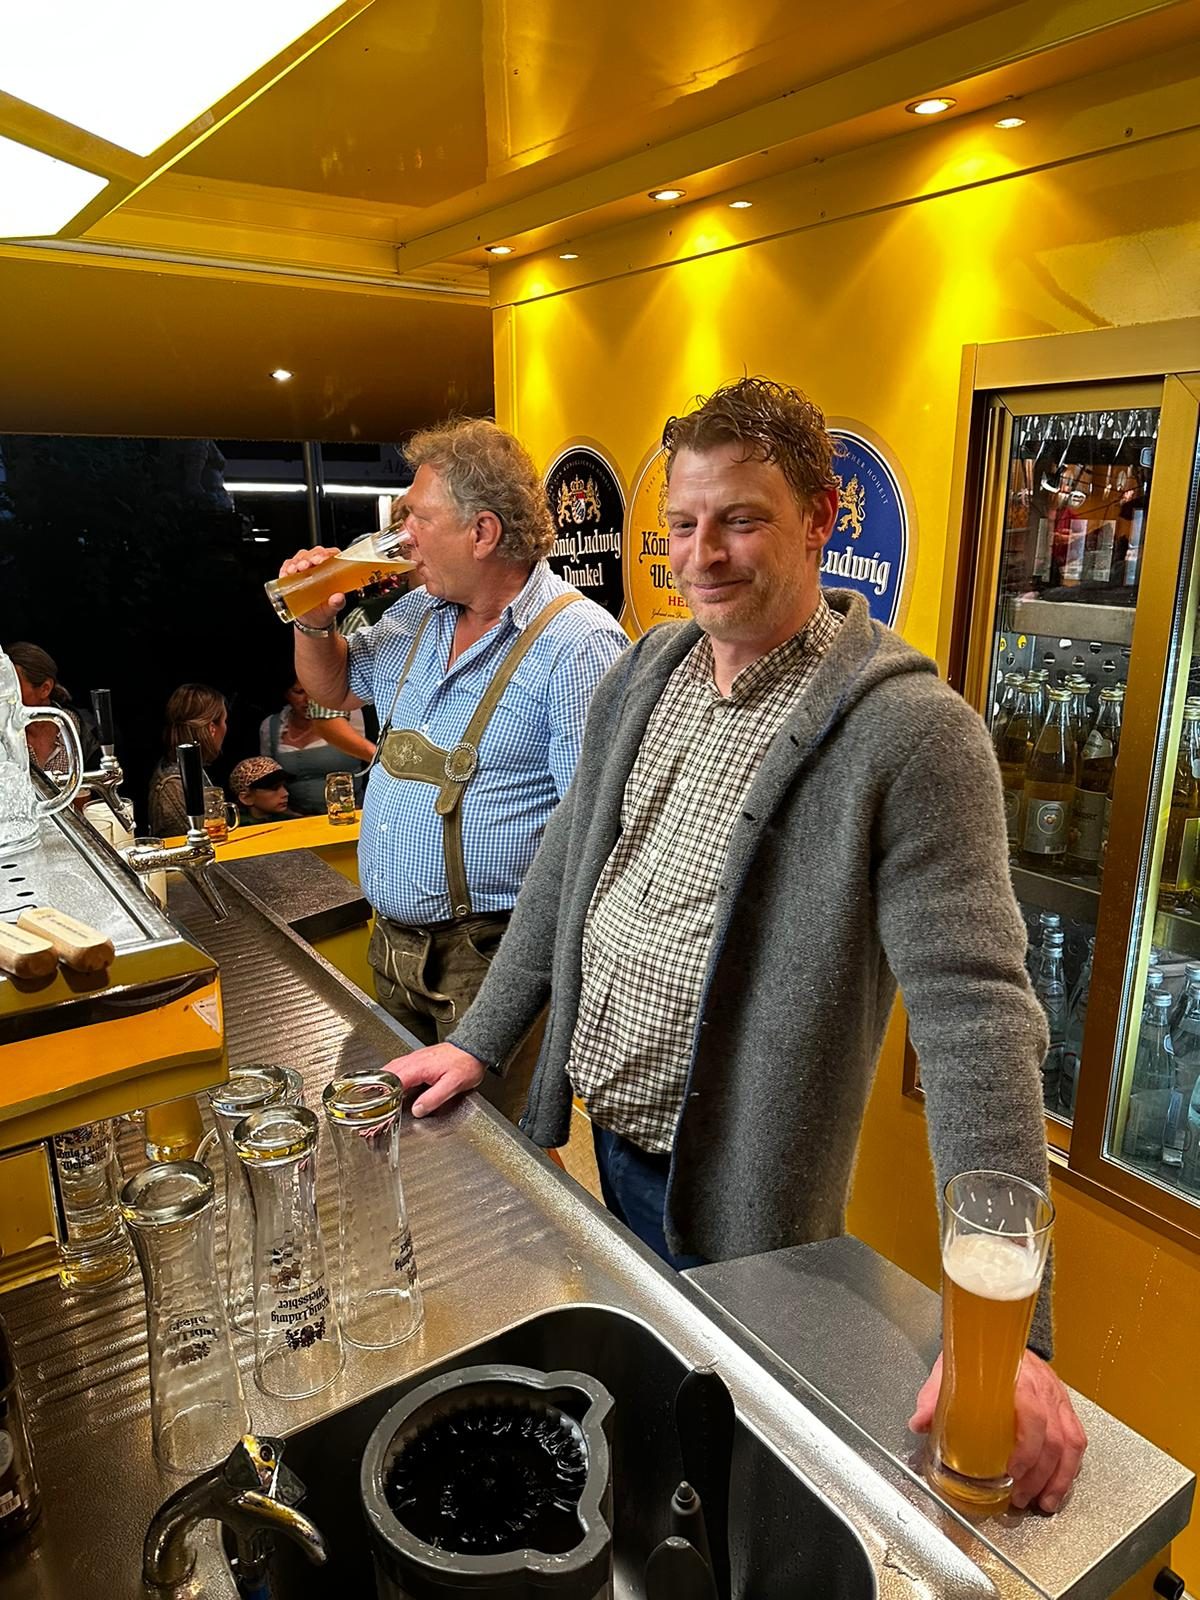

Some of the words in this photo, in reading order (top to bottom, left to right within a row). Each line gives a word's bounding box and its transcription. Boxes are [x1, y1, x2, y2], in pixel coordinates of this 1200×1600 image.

[546, 531, 576, 563] önig
[570, 527, 621, 564] Ludwig
[638, 531, 670, 564] Köni
[563, 562, 604, 587] Dunkel
[649, 563, 677, 590] We
[819, 545, 892, 596] udwig
[278, 1284, 325, 1310] Weissbier
[271, 1310, 310, 1325] Ludwig
